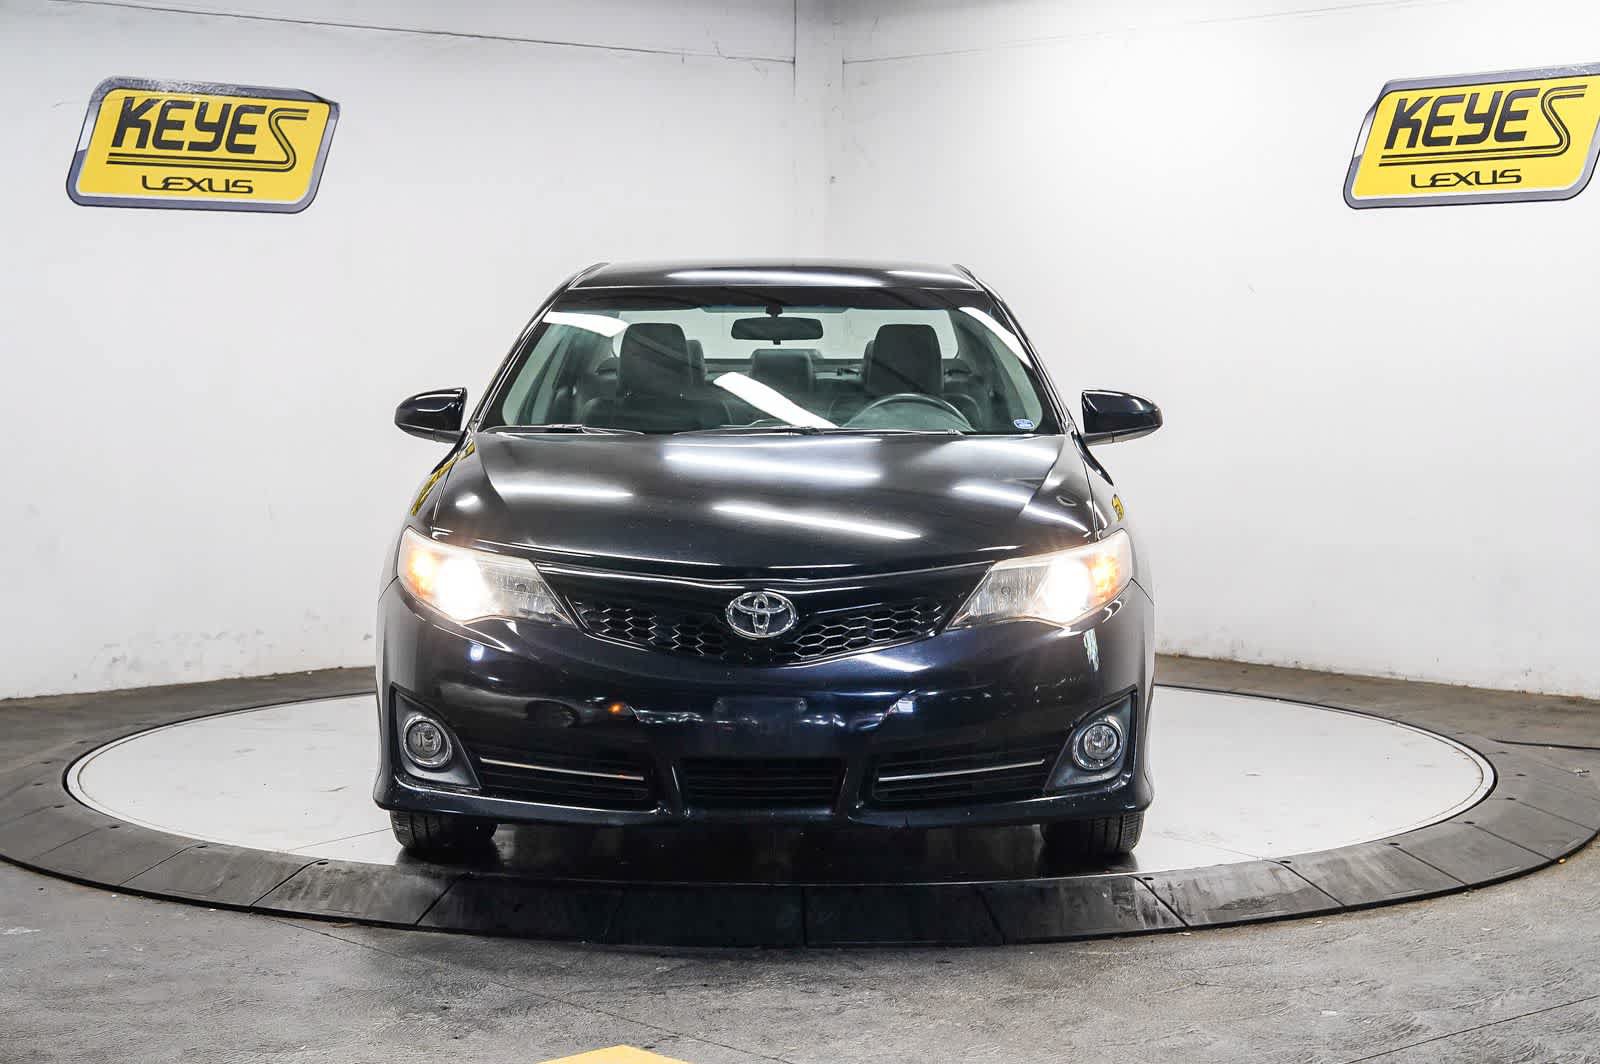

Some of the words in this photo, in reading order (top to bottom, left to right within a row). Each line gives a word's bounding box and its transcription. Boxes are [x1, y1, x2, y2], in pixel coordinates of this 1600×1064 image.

[106, 96, 310, 172] KEYES
[1379, 84, 1588, 167] KEYES
[142, 175, 253, 194] LEXUS
[1411, 168, 1522, 188] LEXUS
